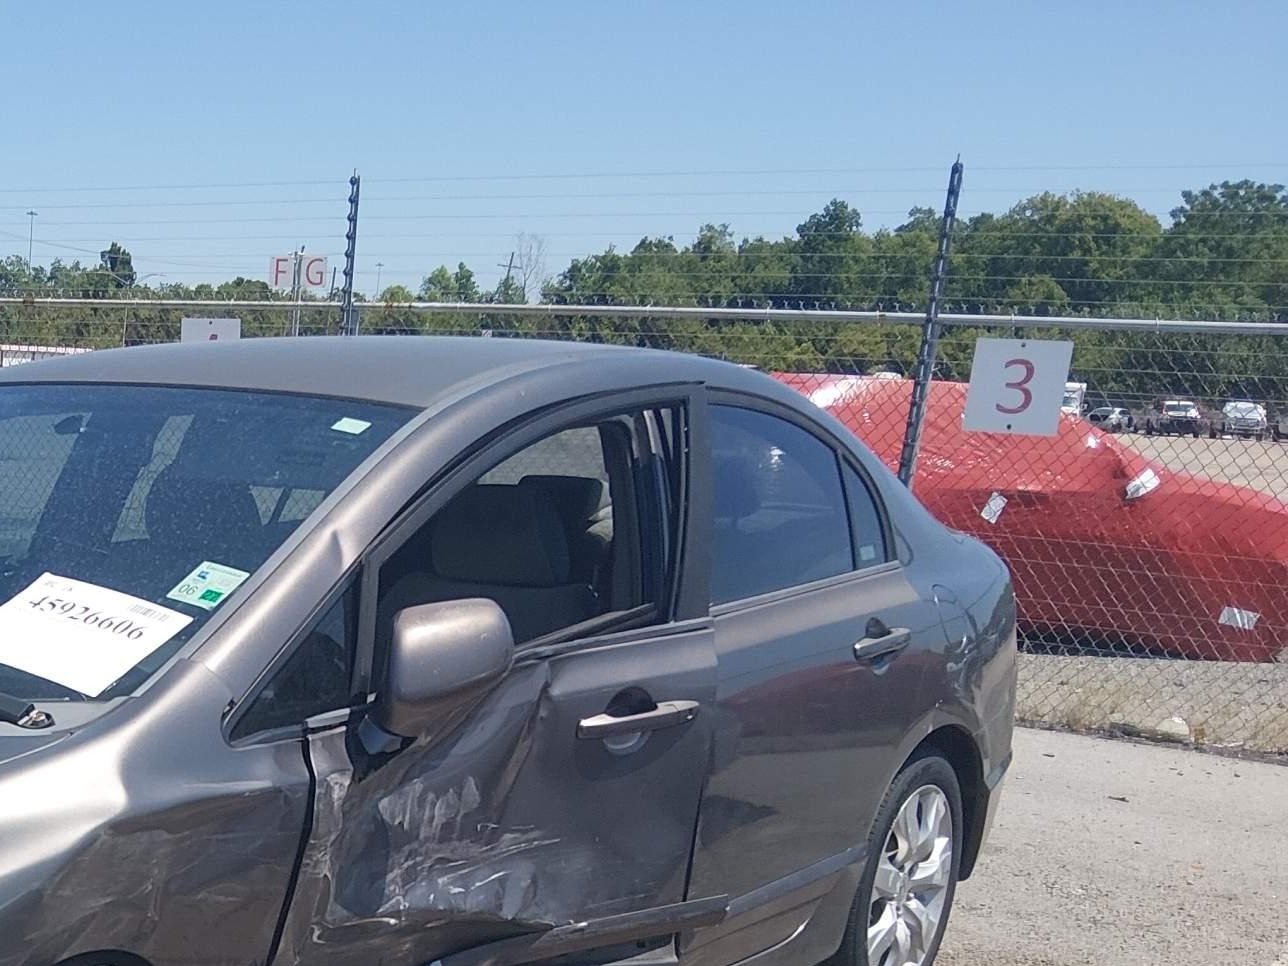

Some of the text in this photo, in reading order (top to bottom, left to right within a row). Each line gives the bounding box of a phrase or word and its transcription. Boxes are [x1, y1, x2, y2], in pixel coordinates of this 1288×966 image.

[275, 258, 289, 286] F
[306, 258, 324, 286] G
[995, 358, 1035, 415] 3
[28, 596, 149, 641] 45926606
